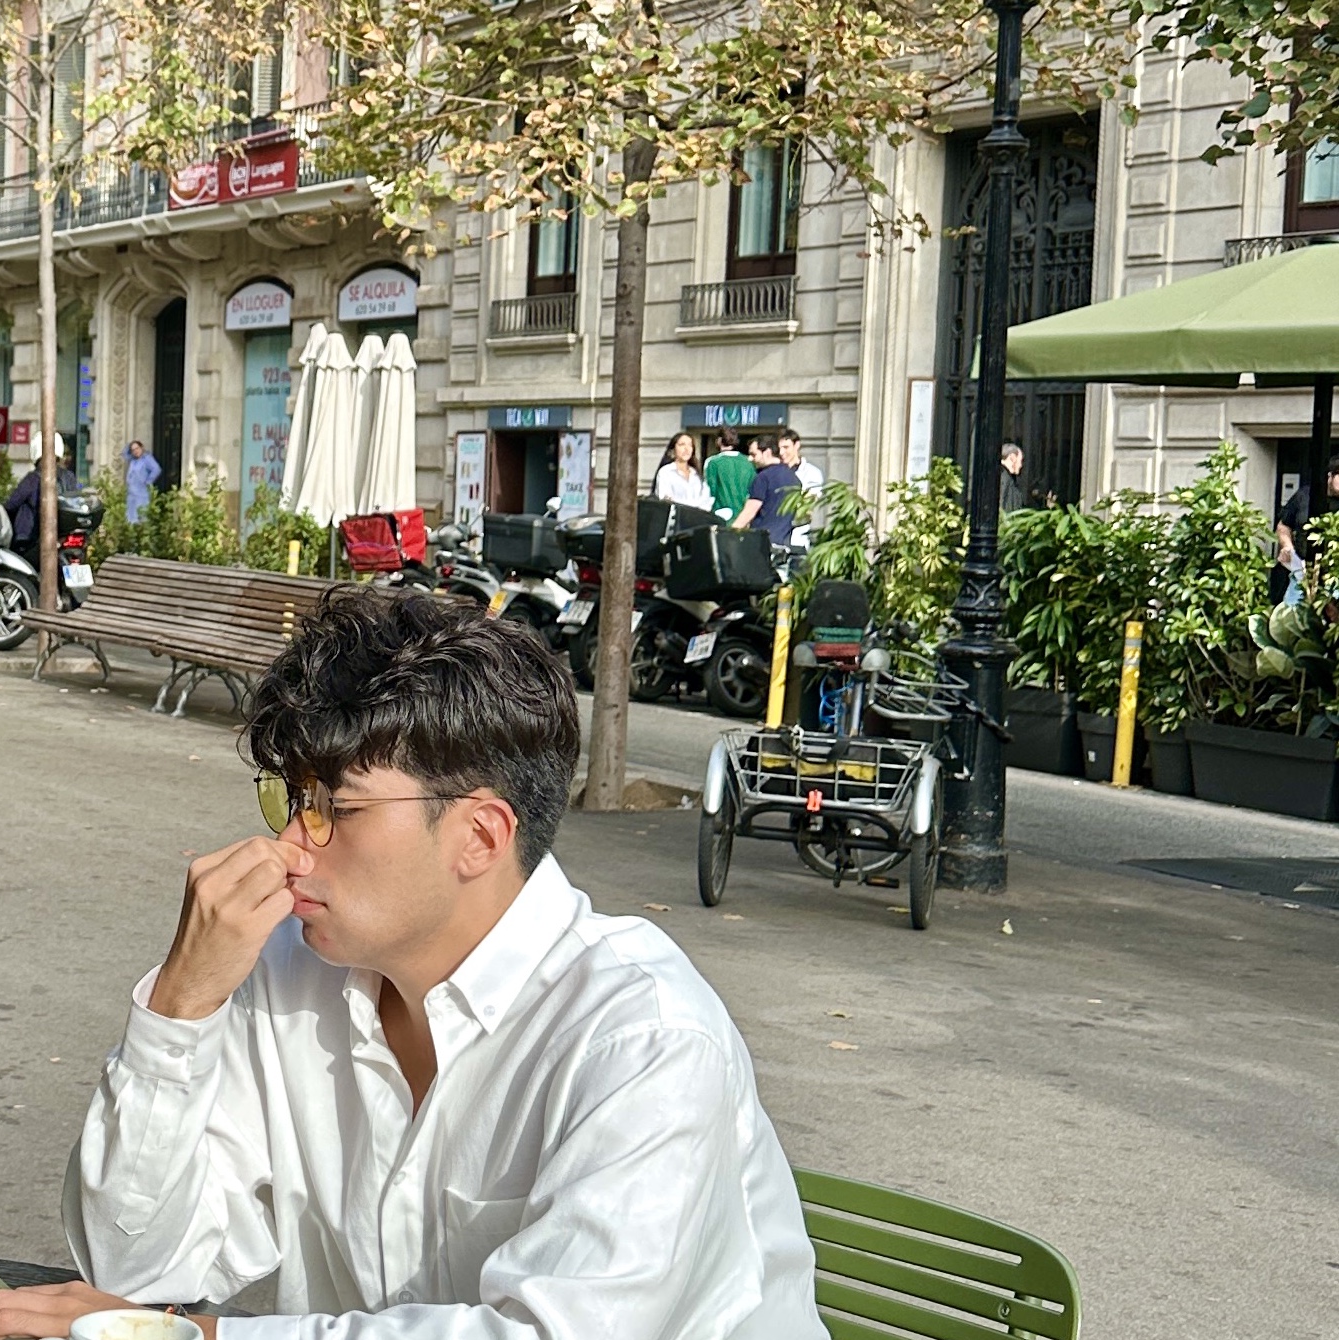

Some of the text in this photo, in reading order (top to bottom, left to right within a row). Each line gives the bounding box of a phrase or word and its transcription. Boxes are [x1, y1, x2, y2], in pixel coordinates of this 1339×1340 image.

[349, 280, 406, 302] SE ALQUILA
[232, 292, 284, 312] EN LLOGUER
[262, 367, 279, 383] 923
[252, 423, 262, 441] EL
[262, 443, 286, 463] LOC
